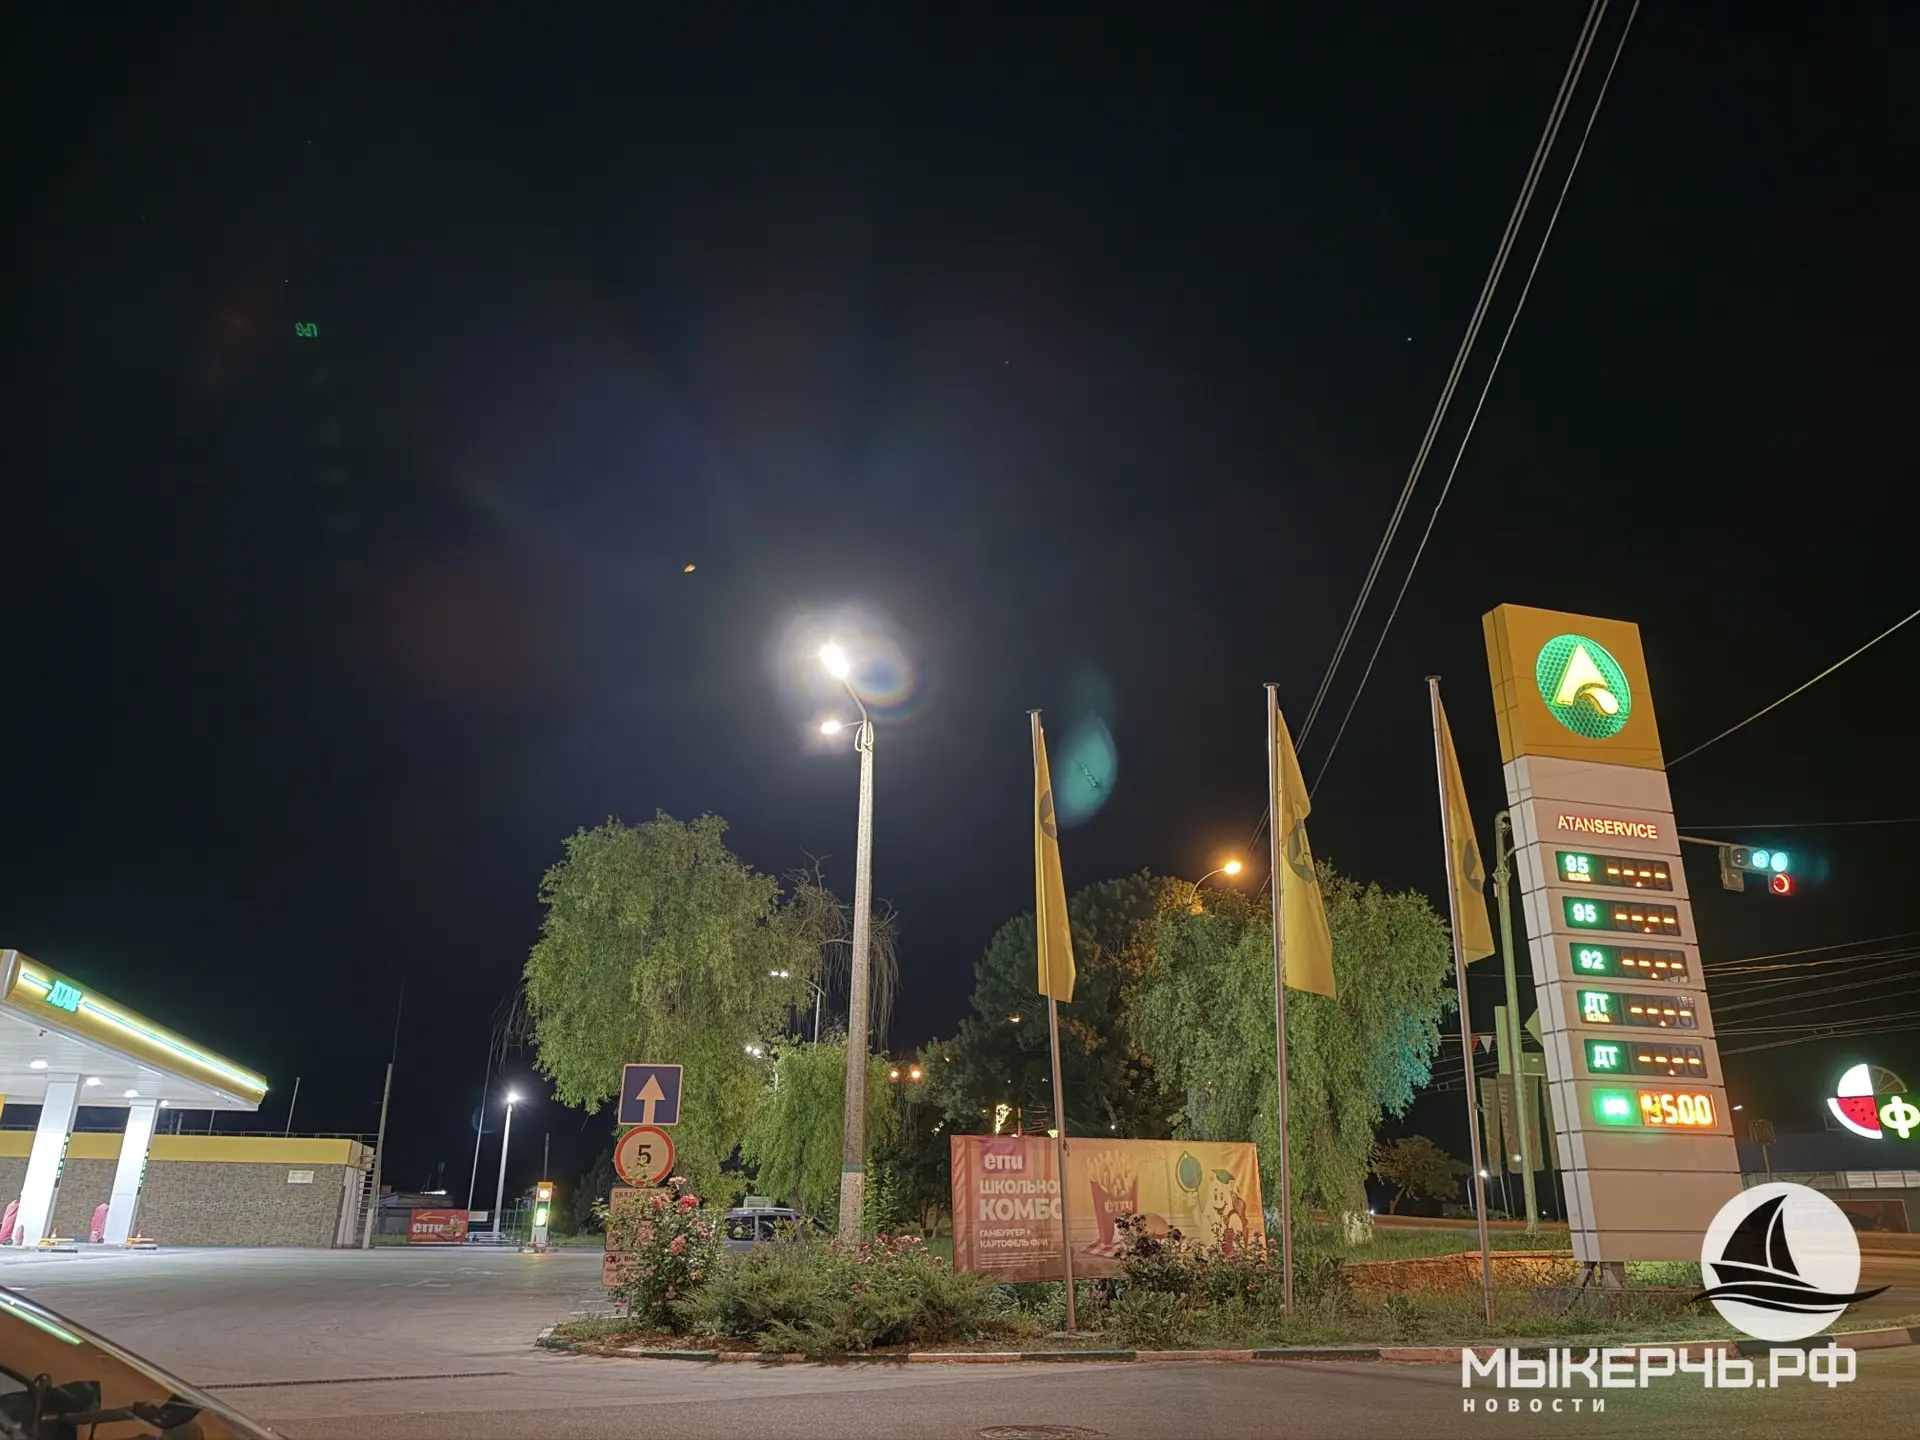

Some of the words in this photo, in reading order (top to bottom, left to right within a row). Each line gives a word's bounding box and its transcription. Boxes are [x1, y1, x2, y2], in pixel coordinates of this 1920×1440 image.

[1558, 815, 1658, 839] ATANSERVICE
[1565, 855, 1589, 874] 95
[1573, 903, 1597, 922] 95
[1580, 949, 1605, 970] 92
[1584, 991, 1609, 1014] ДТ
[1593, 1045, 1619, 1069] ДТ
[638, 1144, 652, 1167] 5
[980, 1180, 1060, 1194] ШКОЛЬНО
[980, 1198, 1062, 1221] КОМБО
[980, 1228, 1025, 1237] ГАМБУРГЕР
[980, 1238, 1029, 1248] КАРТОФЕЛЬ
